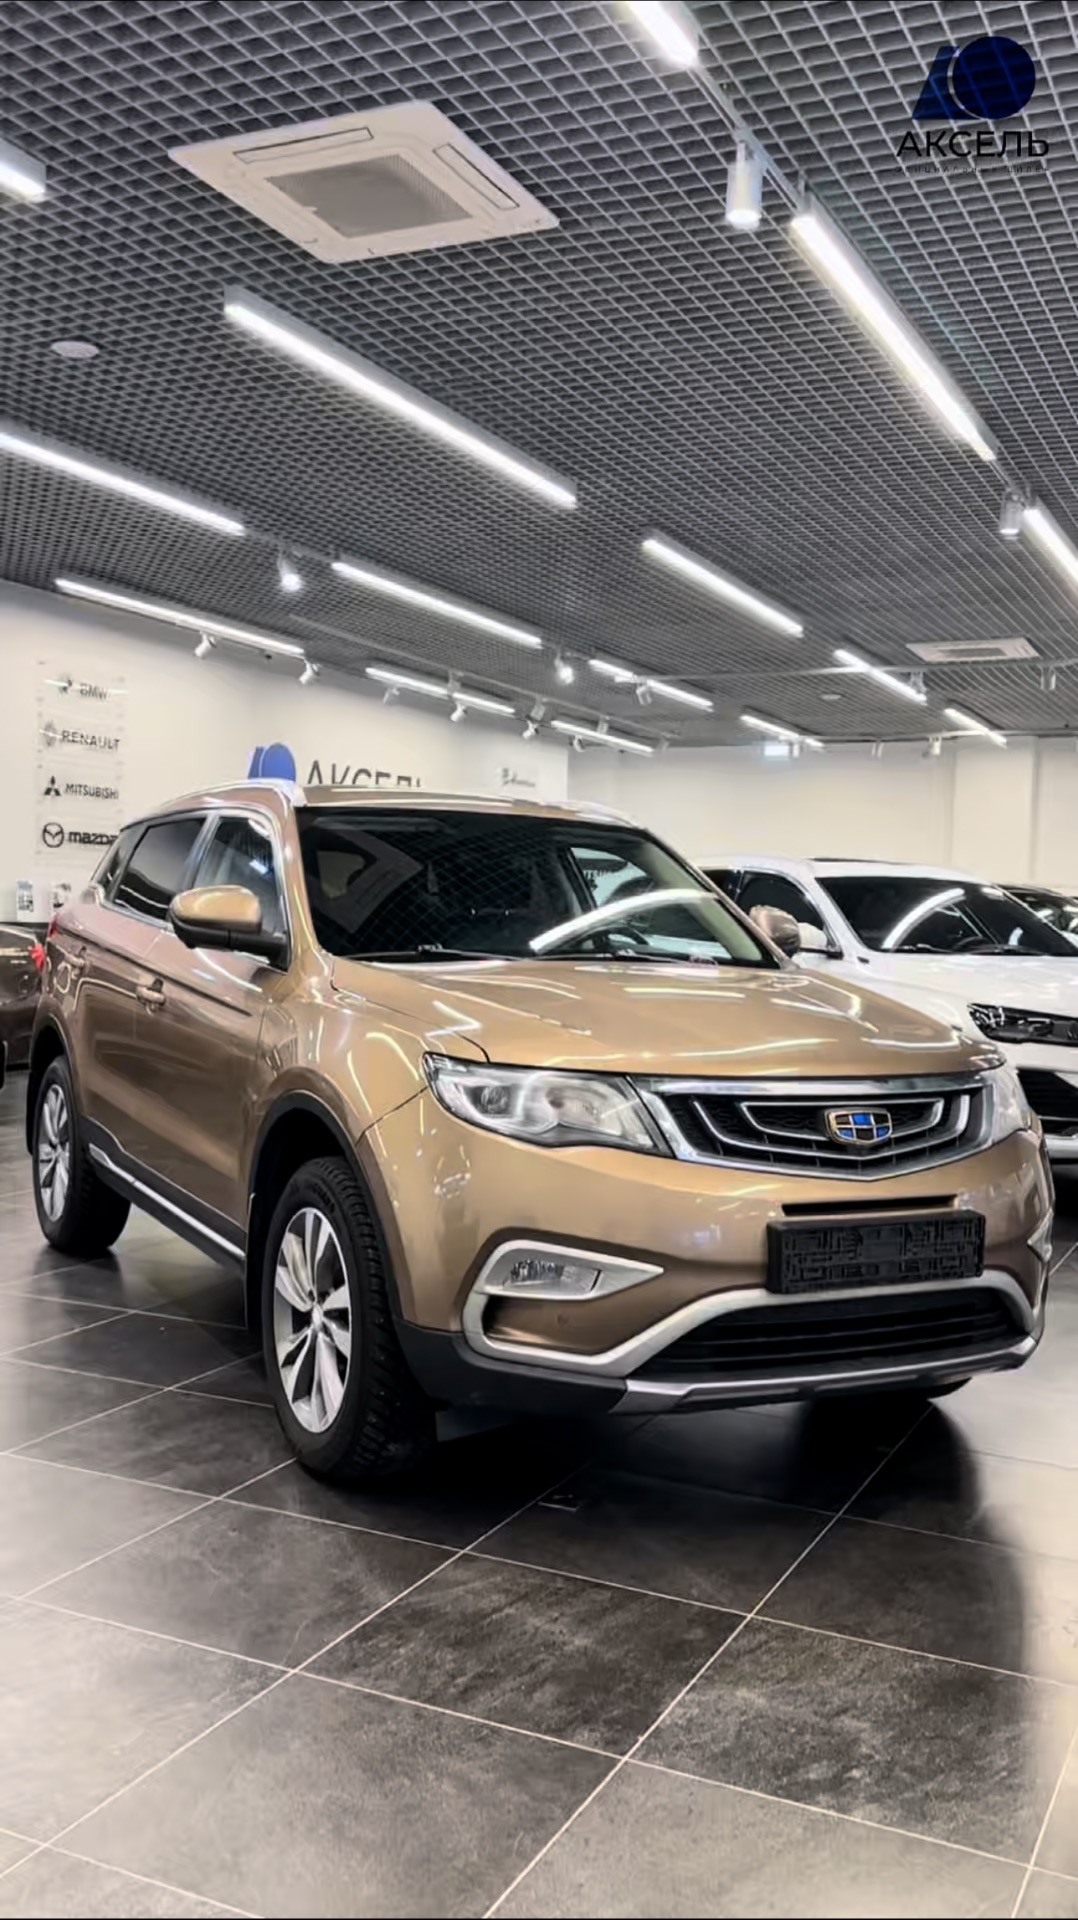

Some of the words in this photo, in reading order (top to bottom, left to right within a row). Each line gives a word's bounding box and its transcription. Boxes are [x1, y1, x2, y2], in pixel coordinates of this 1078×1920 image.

[61, 729, 120, 751] RENAULT
[307, 760, 421, 787] АКС
[65, 783, 119, 799] MITSUBISHI
